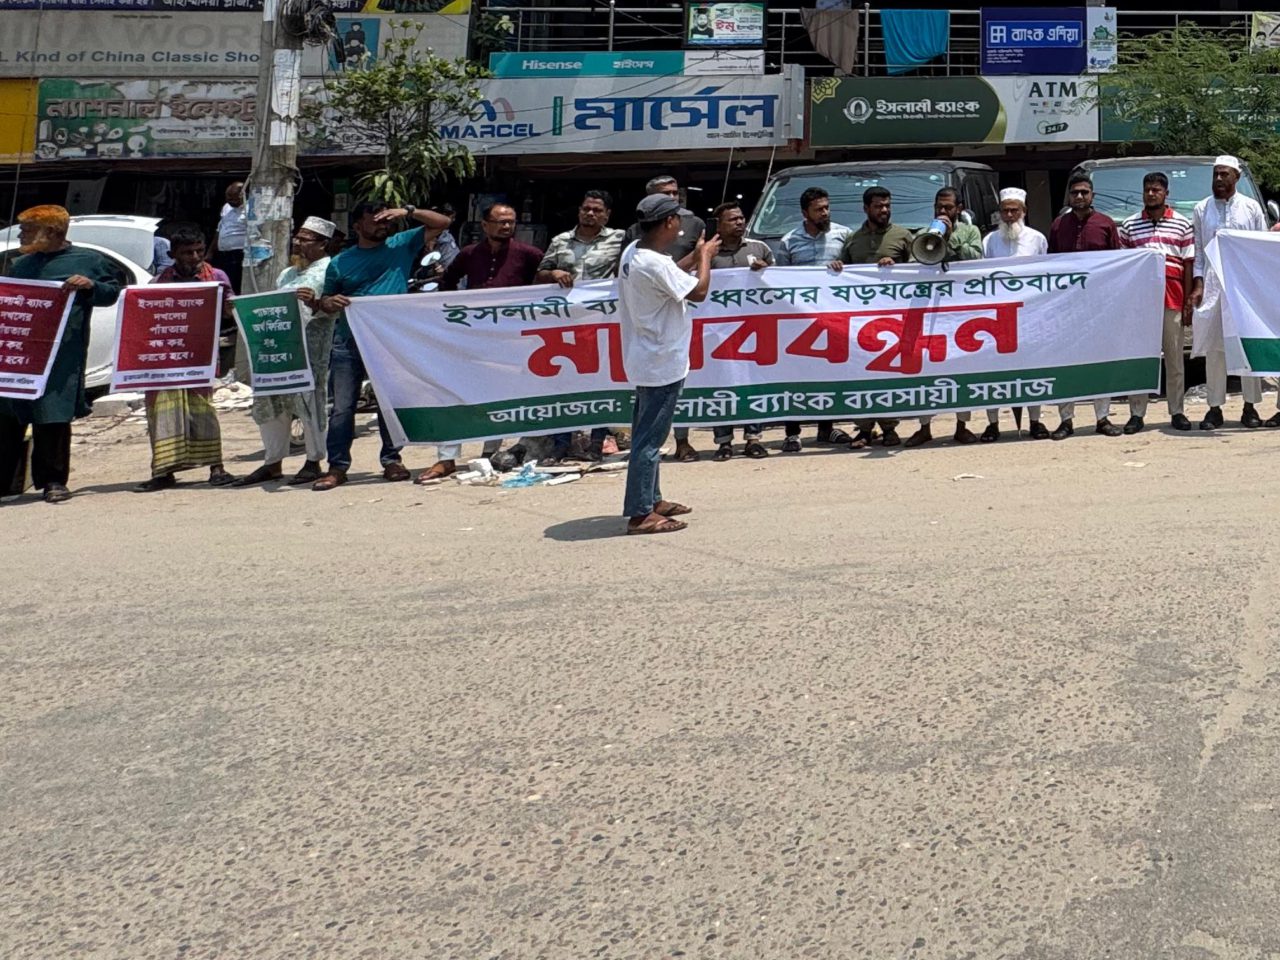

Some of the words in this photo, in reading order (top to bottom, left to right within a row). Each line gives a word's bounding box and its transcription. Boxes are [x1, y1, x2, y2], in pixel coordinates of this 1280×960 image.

[1011, 28, 1045, 42] ব্যাংক
[1046, 25, 1079, 43] এশিয়া
[16, 50, 60, 63] Kind
[66, 50, 86, 63] of
[91, 50, 145, 63] China
[151, 50, 219, 63] Classic
[224, 50, 260, 63] Sho
[522, 59, 583, 70] Hisense
[1028, 81, 1078, 98] ATM
[876, 98, 932, 114] ইসলামী
[935, 100, 981, 114] ব্যাংক
[441, 123, 541, 140] MARCEL
[1045, 122, 1066, 134] 24/7
[137, 297, 174, 309] ইসলামী
[178, 298, 205, 308] ব্যাংক
[442, 295, 573, 327] ইসলামী
[711, 284, 822, 308] ধ্বংসের
[831, 279, 957, 306] ষড়যন্ত্রের
[963, 271, 1091, 301] প্রতিবাদে
[154, 312, 188, 321] দখলের
[521, 301, 1024, 383] মাববন্ধন
[137, 352, 167, 362] করতে
[487, 397, 622, 425] আয়োজনে:
[748, 390, 836, 415] ব্যাংক
[843, 378, 960, 411] ব্যবসায়ী
[967, 377, 1056, 401] সমাজ
